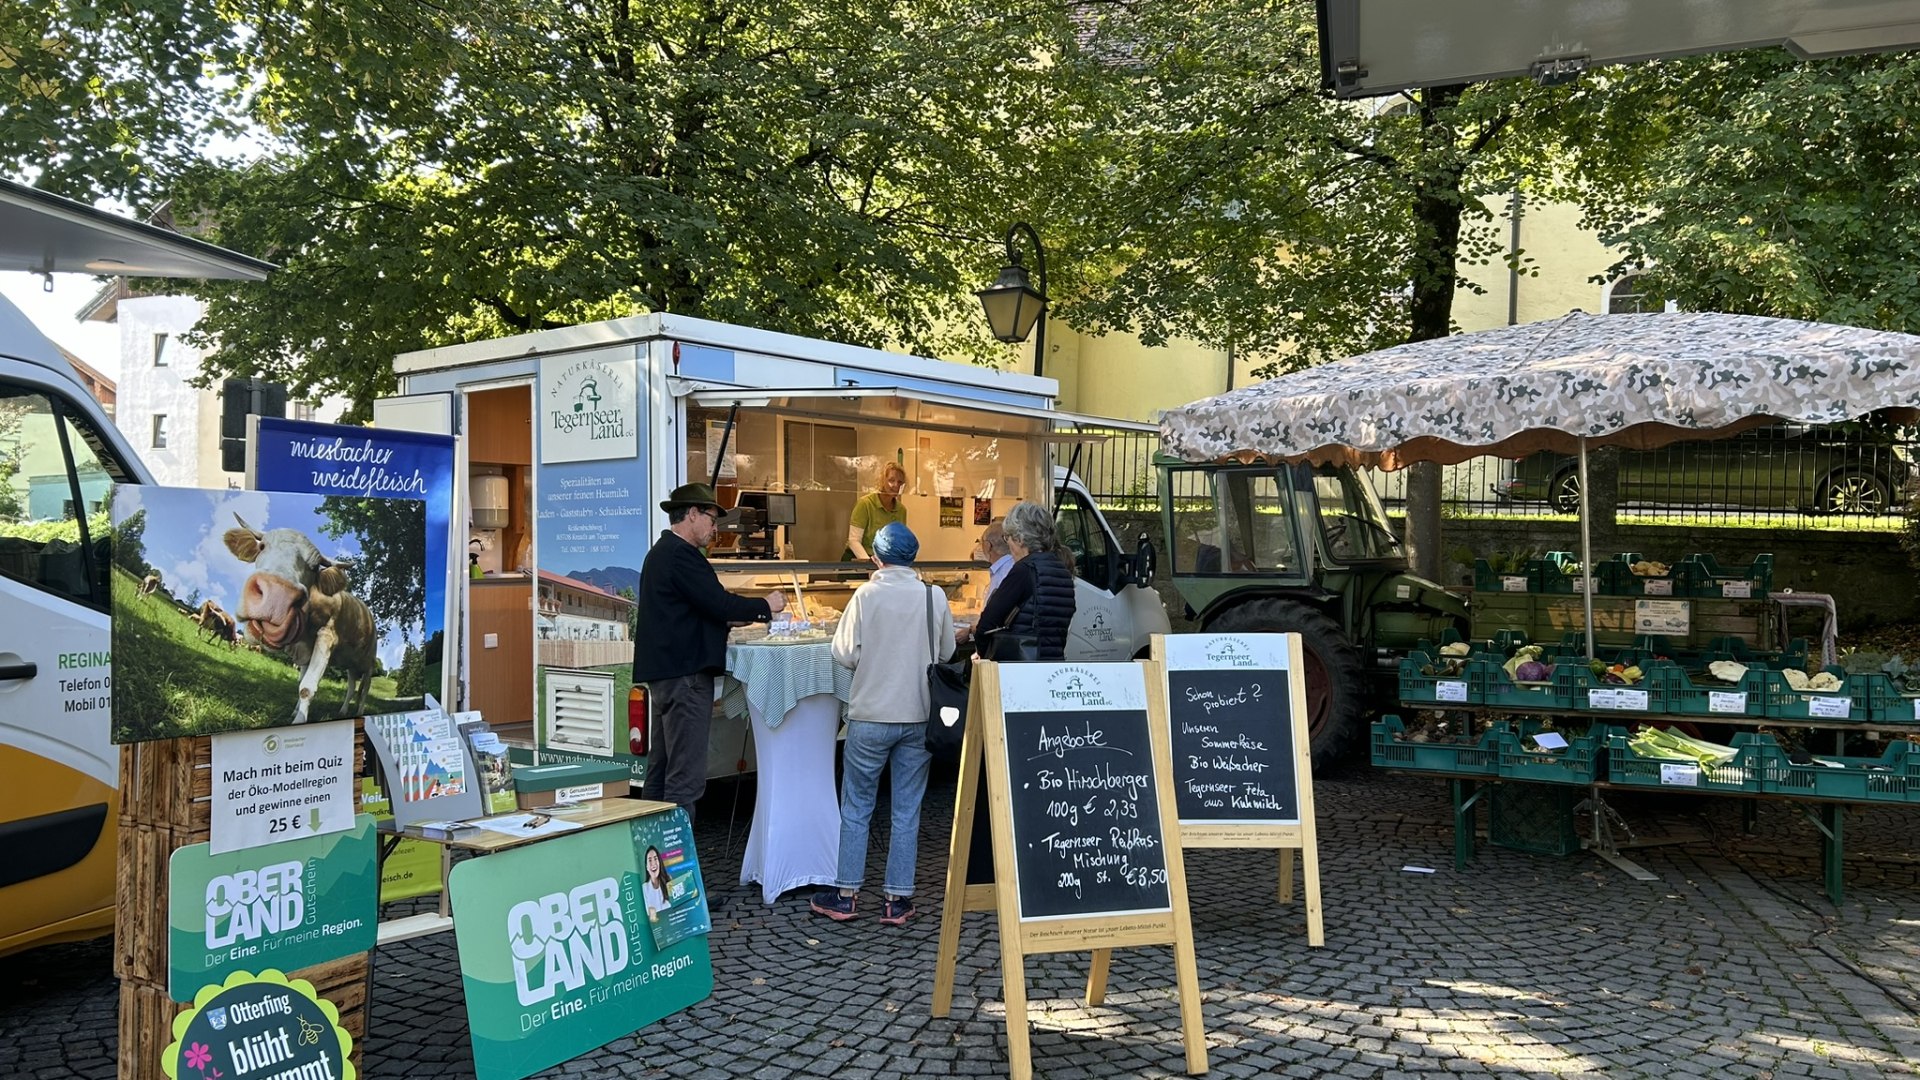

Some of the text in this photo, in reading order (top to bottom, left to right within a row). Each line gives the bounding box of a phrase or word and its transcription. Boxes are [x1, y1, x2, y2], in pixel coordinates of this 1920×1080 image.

[551, 409, 621, 434] Tegernseer
[591, 417, 624, 440] Land
[289, 436, 394, 465] miesbacher
[311, 466, 428, 498] weidefleisch
[548, 488, 629, 501] unserer feinen Heumilch
[560, 476, 615, 489] Spezialitäten aus
[599, 505, 642, 516] Schaukäserei
[1206, 653, 1250, 662] Tegernseer
[58, 677, 101, 693] Telefon
[1049, 689, 1102, 700] Tegernseer
[1185, 686, 1214, 702] Schon
[64, 697, 96, 713] Mobil
[1082, 697, 1105, 706] Land
[1203, 687, 1247, 715] probiert
[1039, 721, 1107, 758] Angebote
[223, 755, 343, 783] Mach mit beim Quiz
[1188, 755, 1209, 769] Bio
[228, 775, 337, 801] der Öko-Modellregion
[1037, 762, 1148, 800] Bio Hirschberger
[1185, 778, 1269, 799] Tegernseer Feta
[235, 793, 331, 816] und gewinne einen
[1046, 800, 1078, 826] 100g
[1083, 795, 1097, 815] €
[1204, 799, 1224, 808] aus
[269, 815, 301, 834] 25 €
[1041, 832, 1102, 859] Tegernseer
[1073, 850, 1129, 875] Mischung
[205, 860, 303, 918] OBER
[305, 858, 316, 925] Gutschein
[205, 890, 304, 950] LAND
[507, 876, 624, 960] OBER
[624, 874, 644, 966] Gutschein
[205, 918, 363, 968] Der Eine. Für meine Region.
[512, 918, 629, 1007] LAND
[520, 954, 694, 1032] Der Eine. Für meine Region.
[230, 994, 293, 1025] Otterfing
[228, 1027, 294, 1076] blüht
